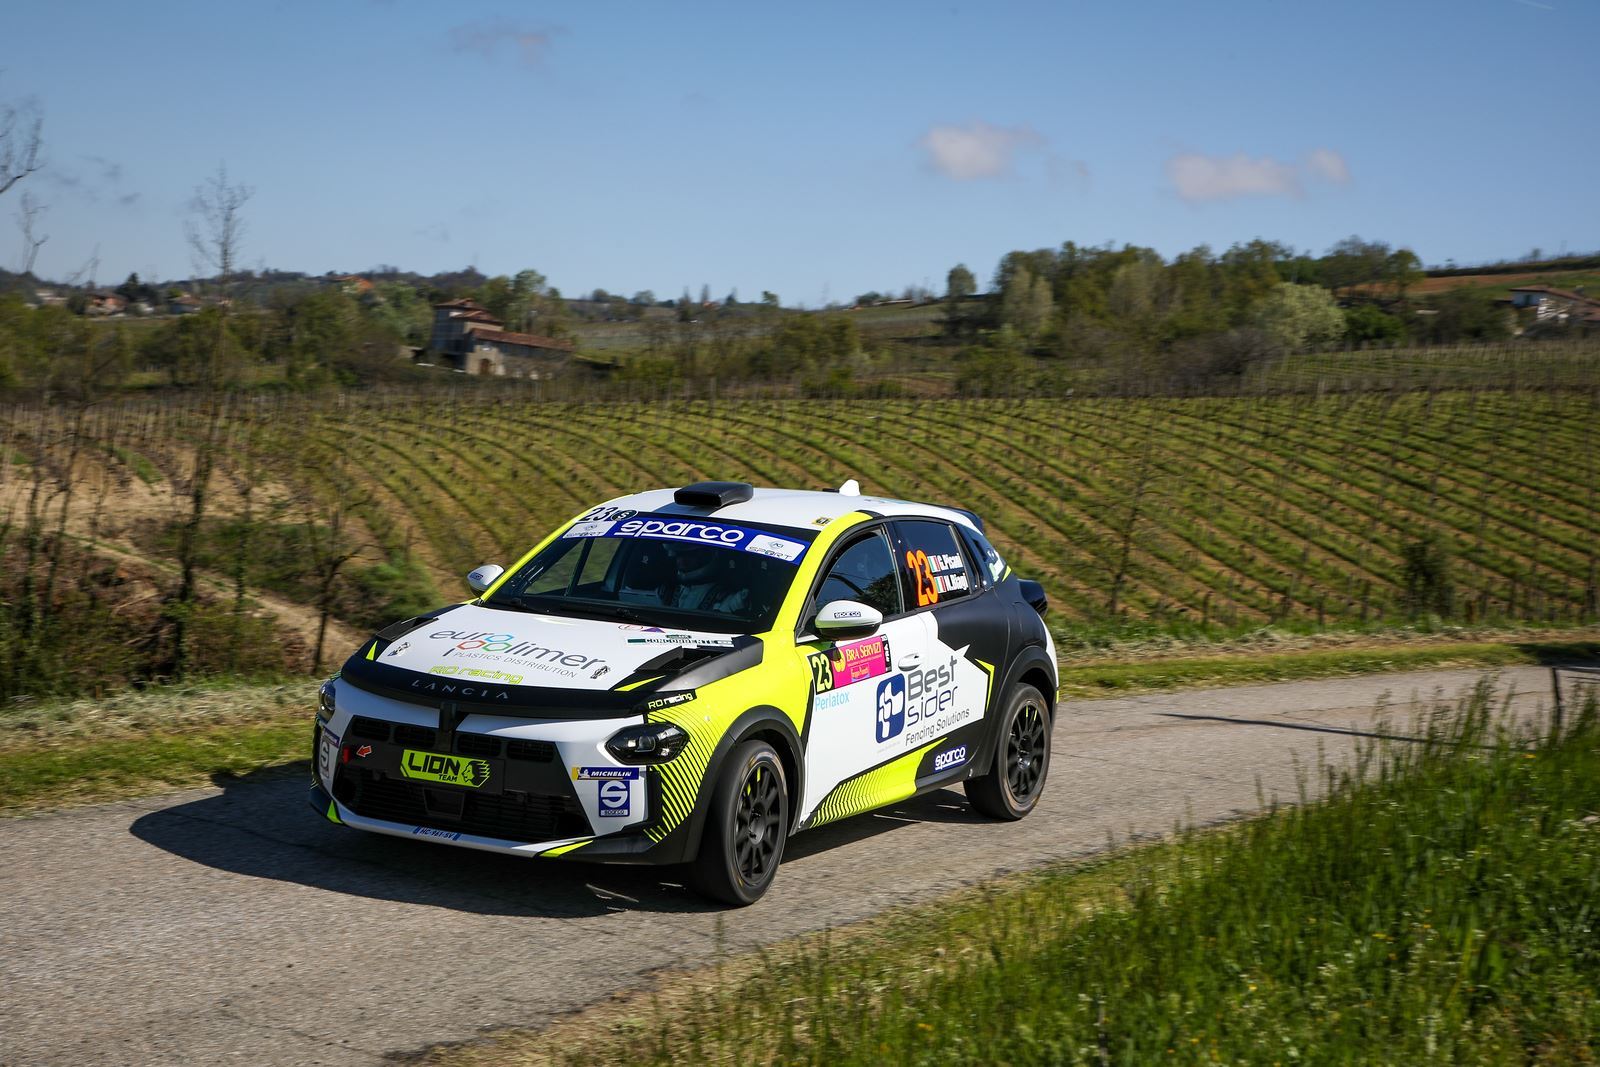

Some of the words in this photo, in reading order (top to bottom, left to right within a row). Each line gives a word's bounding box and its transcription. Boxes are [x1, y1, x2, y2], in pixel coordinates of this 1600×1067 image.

[578, 507, 618, 521] 23
[620, 520, 744, 542] sparco
[749, 546, 793, 559] SPORT
[906, 549, 938, 606] 23
[453, 651, 501, 660] PLASTICS
[503, 657, 577, 678] DISTRIBUTION
[845, 648, 860, 662] BRA
[811, 653, 833, 692] 23
[907, 655, 957, 702] Best
[410, 680, 510, 699] LANCIA
[663, 693, 694, 705] racing
[815, 691, 850, 711] Perlatox
[907, 686, 958, 727] sider
[905, 723, 935, 746] Fencing
[936, 708, 970, 731] Solutions
[408, 752, 461, 776] LION
[934, 746, 966, 769] sparco
[438, 774, 457, 782] TEAM
